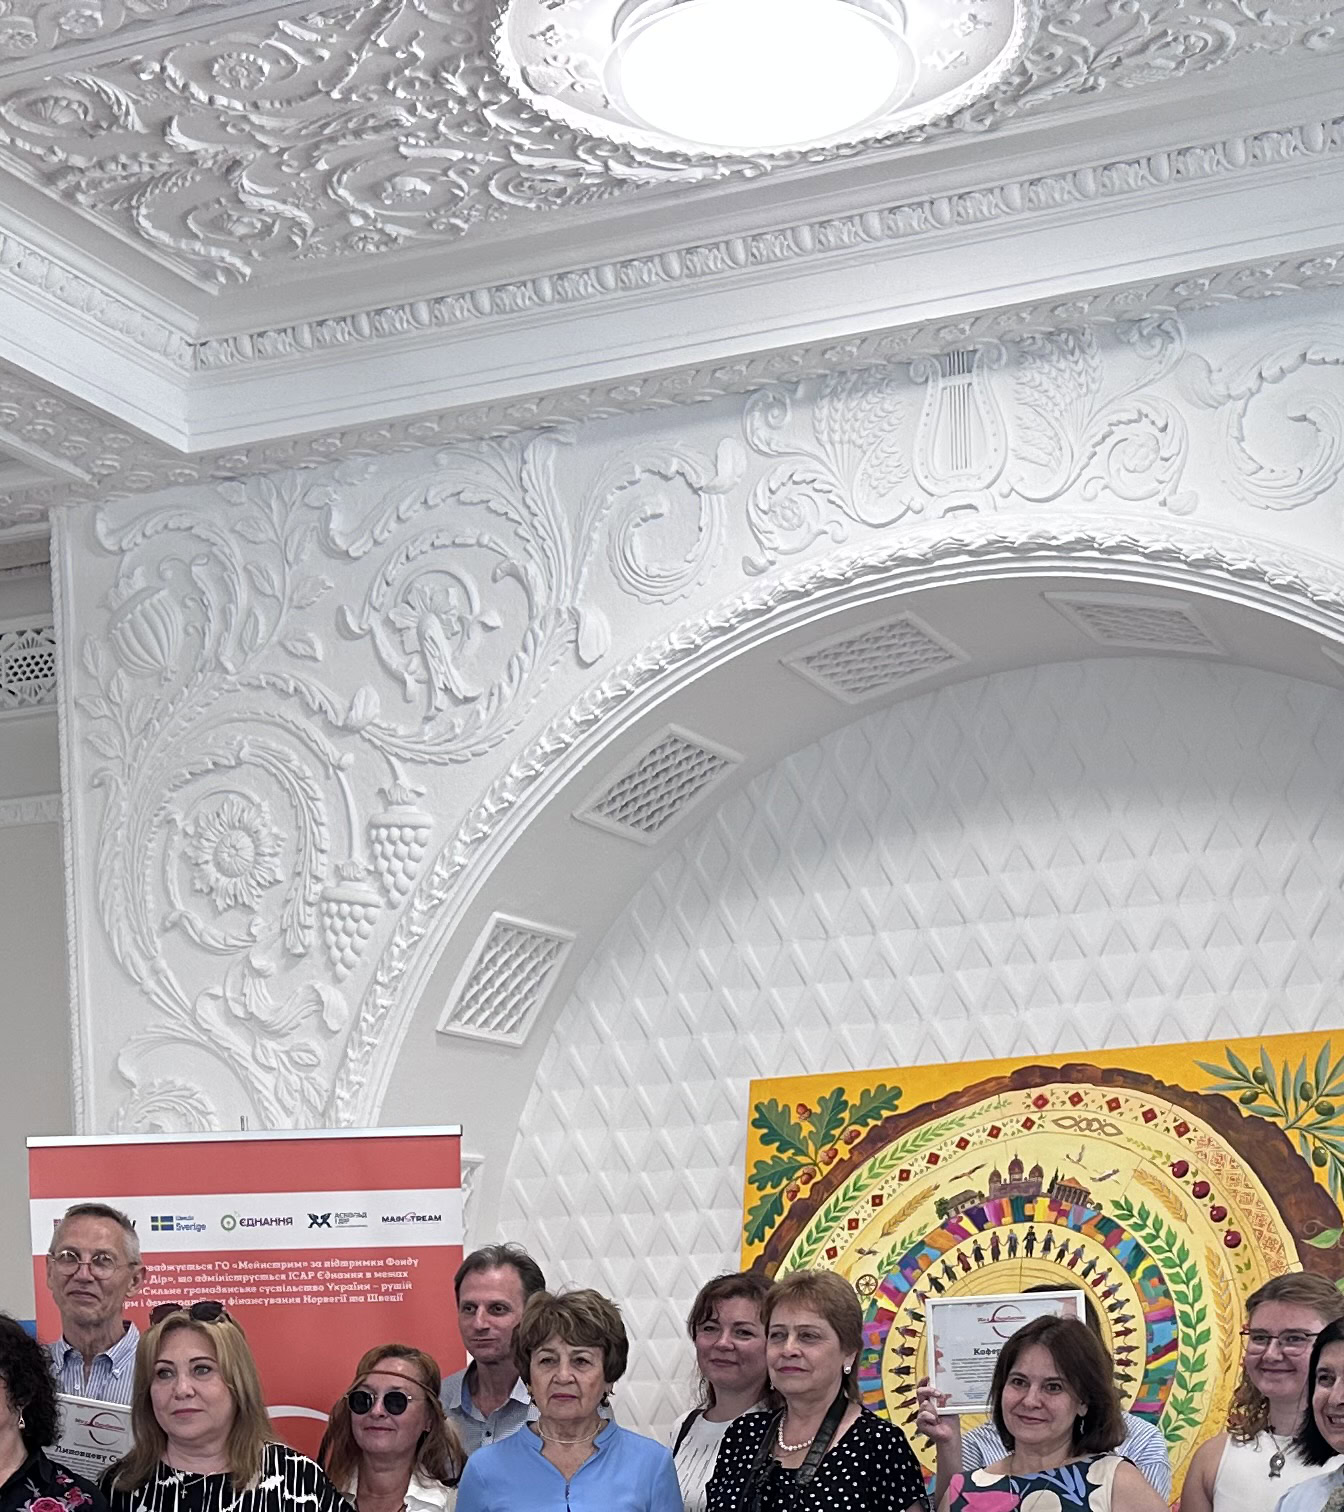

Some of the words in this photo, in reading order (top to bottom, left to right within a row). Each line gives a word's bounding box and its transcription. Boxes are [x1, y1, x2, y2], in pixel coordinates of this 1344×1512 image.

[239, 1216, 293, 1227] ЄДНАННЯ
[381, 1212, 442, 1223] MAINSTREAM
[176, 1223, 206, 1232] Sverige
[215, 1261, 230, 1270] ГО
[324, 1258, 384, 1269] підтримки
[386, 1256, 419, 1267] Фонду
[195, 1272, 286, 1283] адмініструється
[317, 1270, 363, 1280] Єднання
[183, 1285, 256, 1296] громадянське
[259, 1284, 324, 1294] суспільство
[326, 1283, 371, 1292] України
[381, 1282, 413, 1291] рушій
[228, 1296, 302, 1307] фінансування
[303, 1293, 347, 1305] Норвегії
[367, 1293, 404, 1302] Швеції
